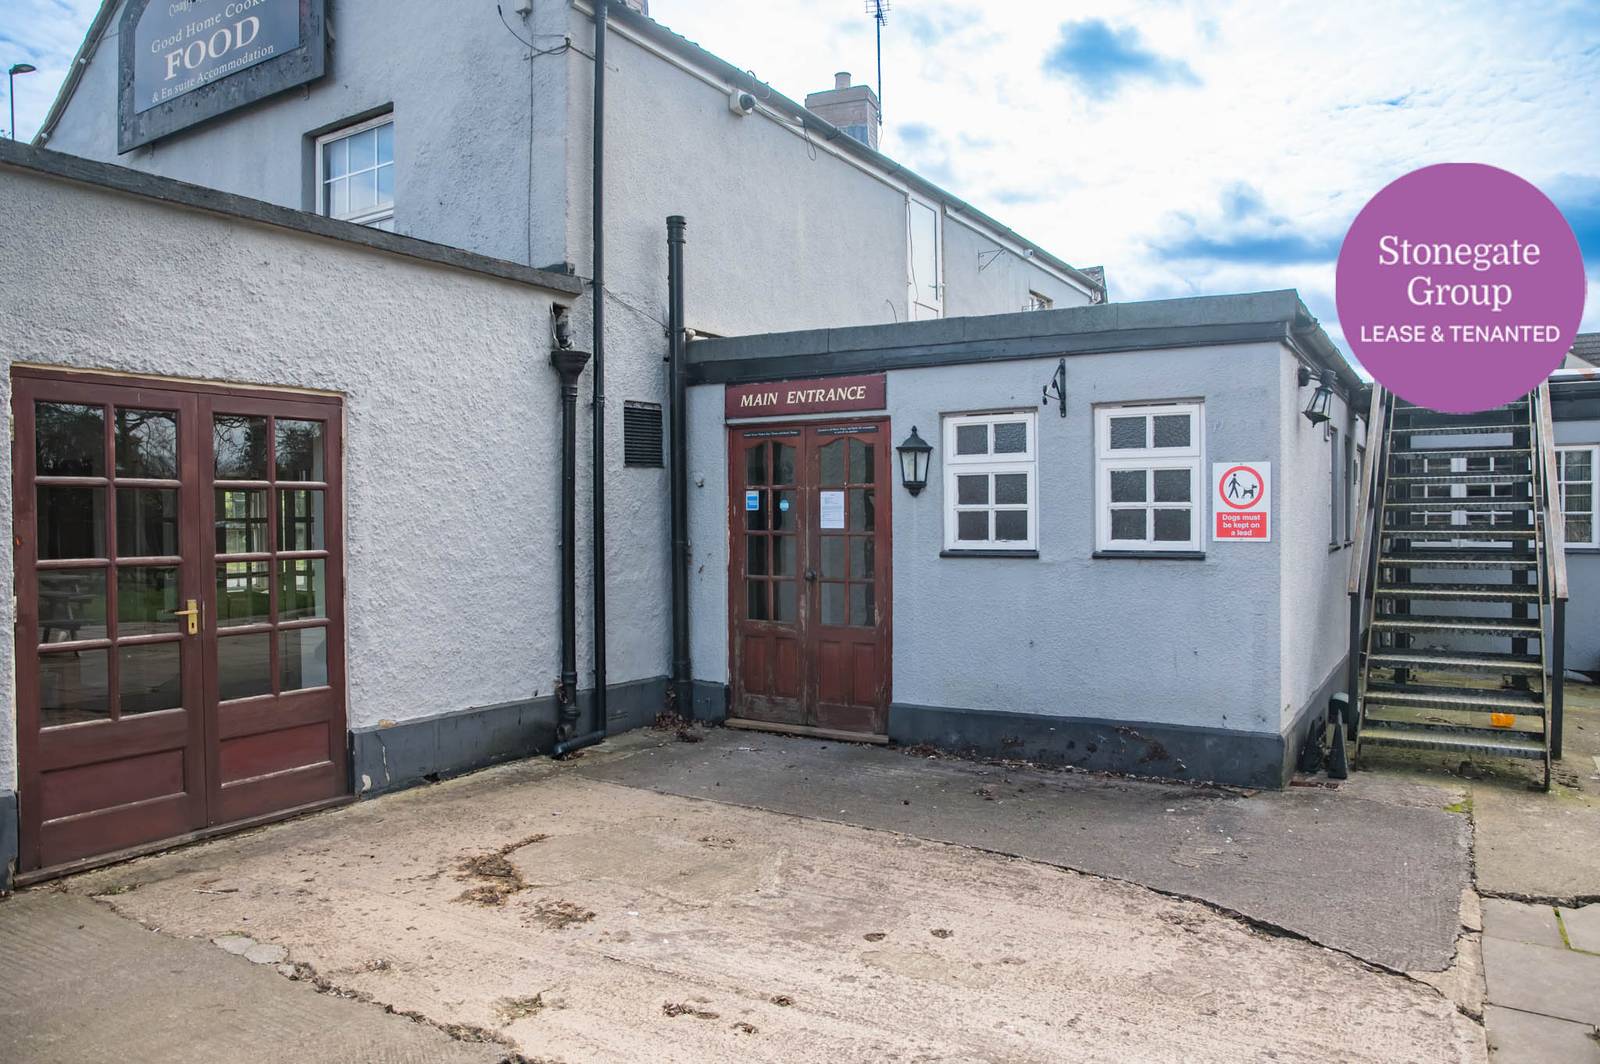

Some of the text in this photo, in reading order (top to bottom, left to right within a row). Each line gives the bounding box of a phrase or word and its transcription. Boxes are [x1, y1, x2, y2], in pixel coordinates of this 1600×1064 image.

[151, 29, 183, 53] Good
[186, 13, 222, 38] Home
[164, 16, 260, 80] FOOD
[152, 91, 159, 103] &
[198, 45, 274, 85] Accommodation
[740, 385, 867, 408] MAIN ENTRANCE
